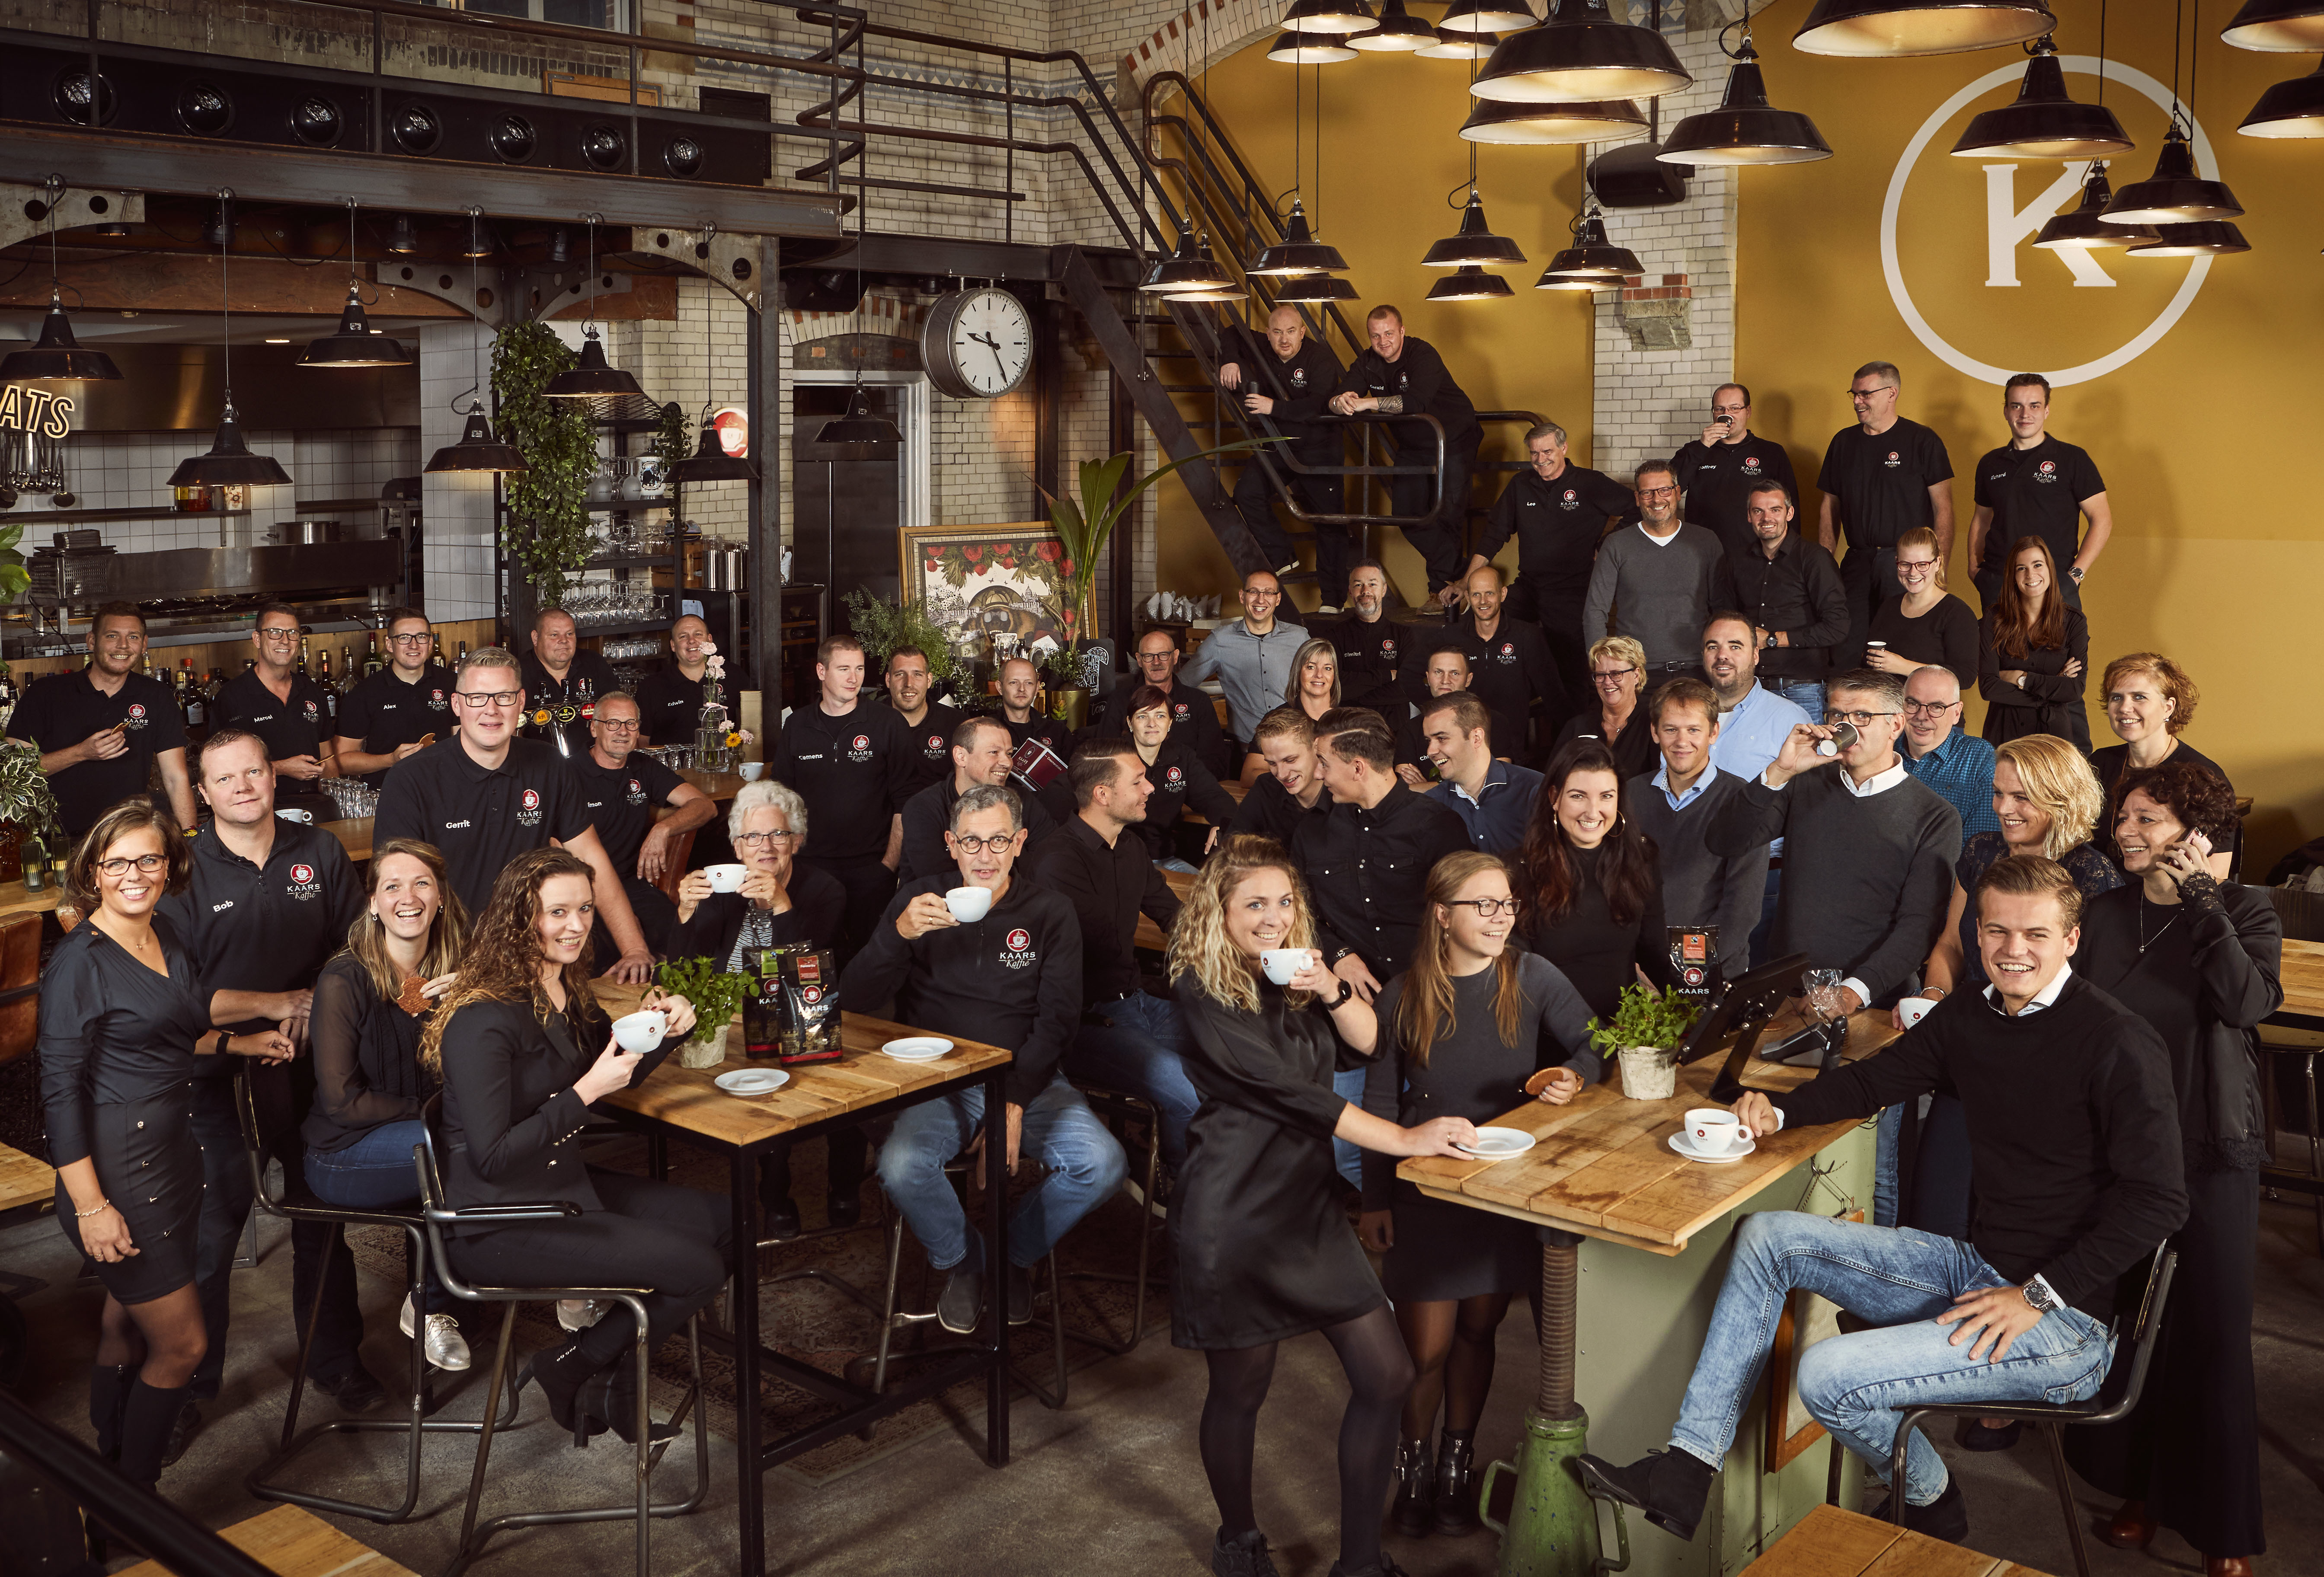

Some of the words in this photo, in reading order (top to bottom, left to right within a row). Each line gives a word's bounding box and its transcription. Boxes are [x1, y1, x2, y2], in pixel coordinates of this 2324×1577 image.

[1982, 160, 2117, 287] K
[253, 714, 273, 723] Marcel
[1018, 757, 1029, 765] KAARS
[446, 820, 471, 829] Gerrit
[521, 817, 540, 826] Koffie
[287, 884, 320, 893] KAARS
[294, 891, 316, 900] Koffie
[213, 900, 234, 913] Bob
[999, 951, 1036, 960] KAARS
[1005, 958, 1030, 969] Koffie
